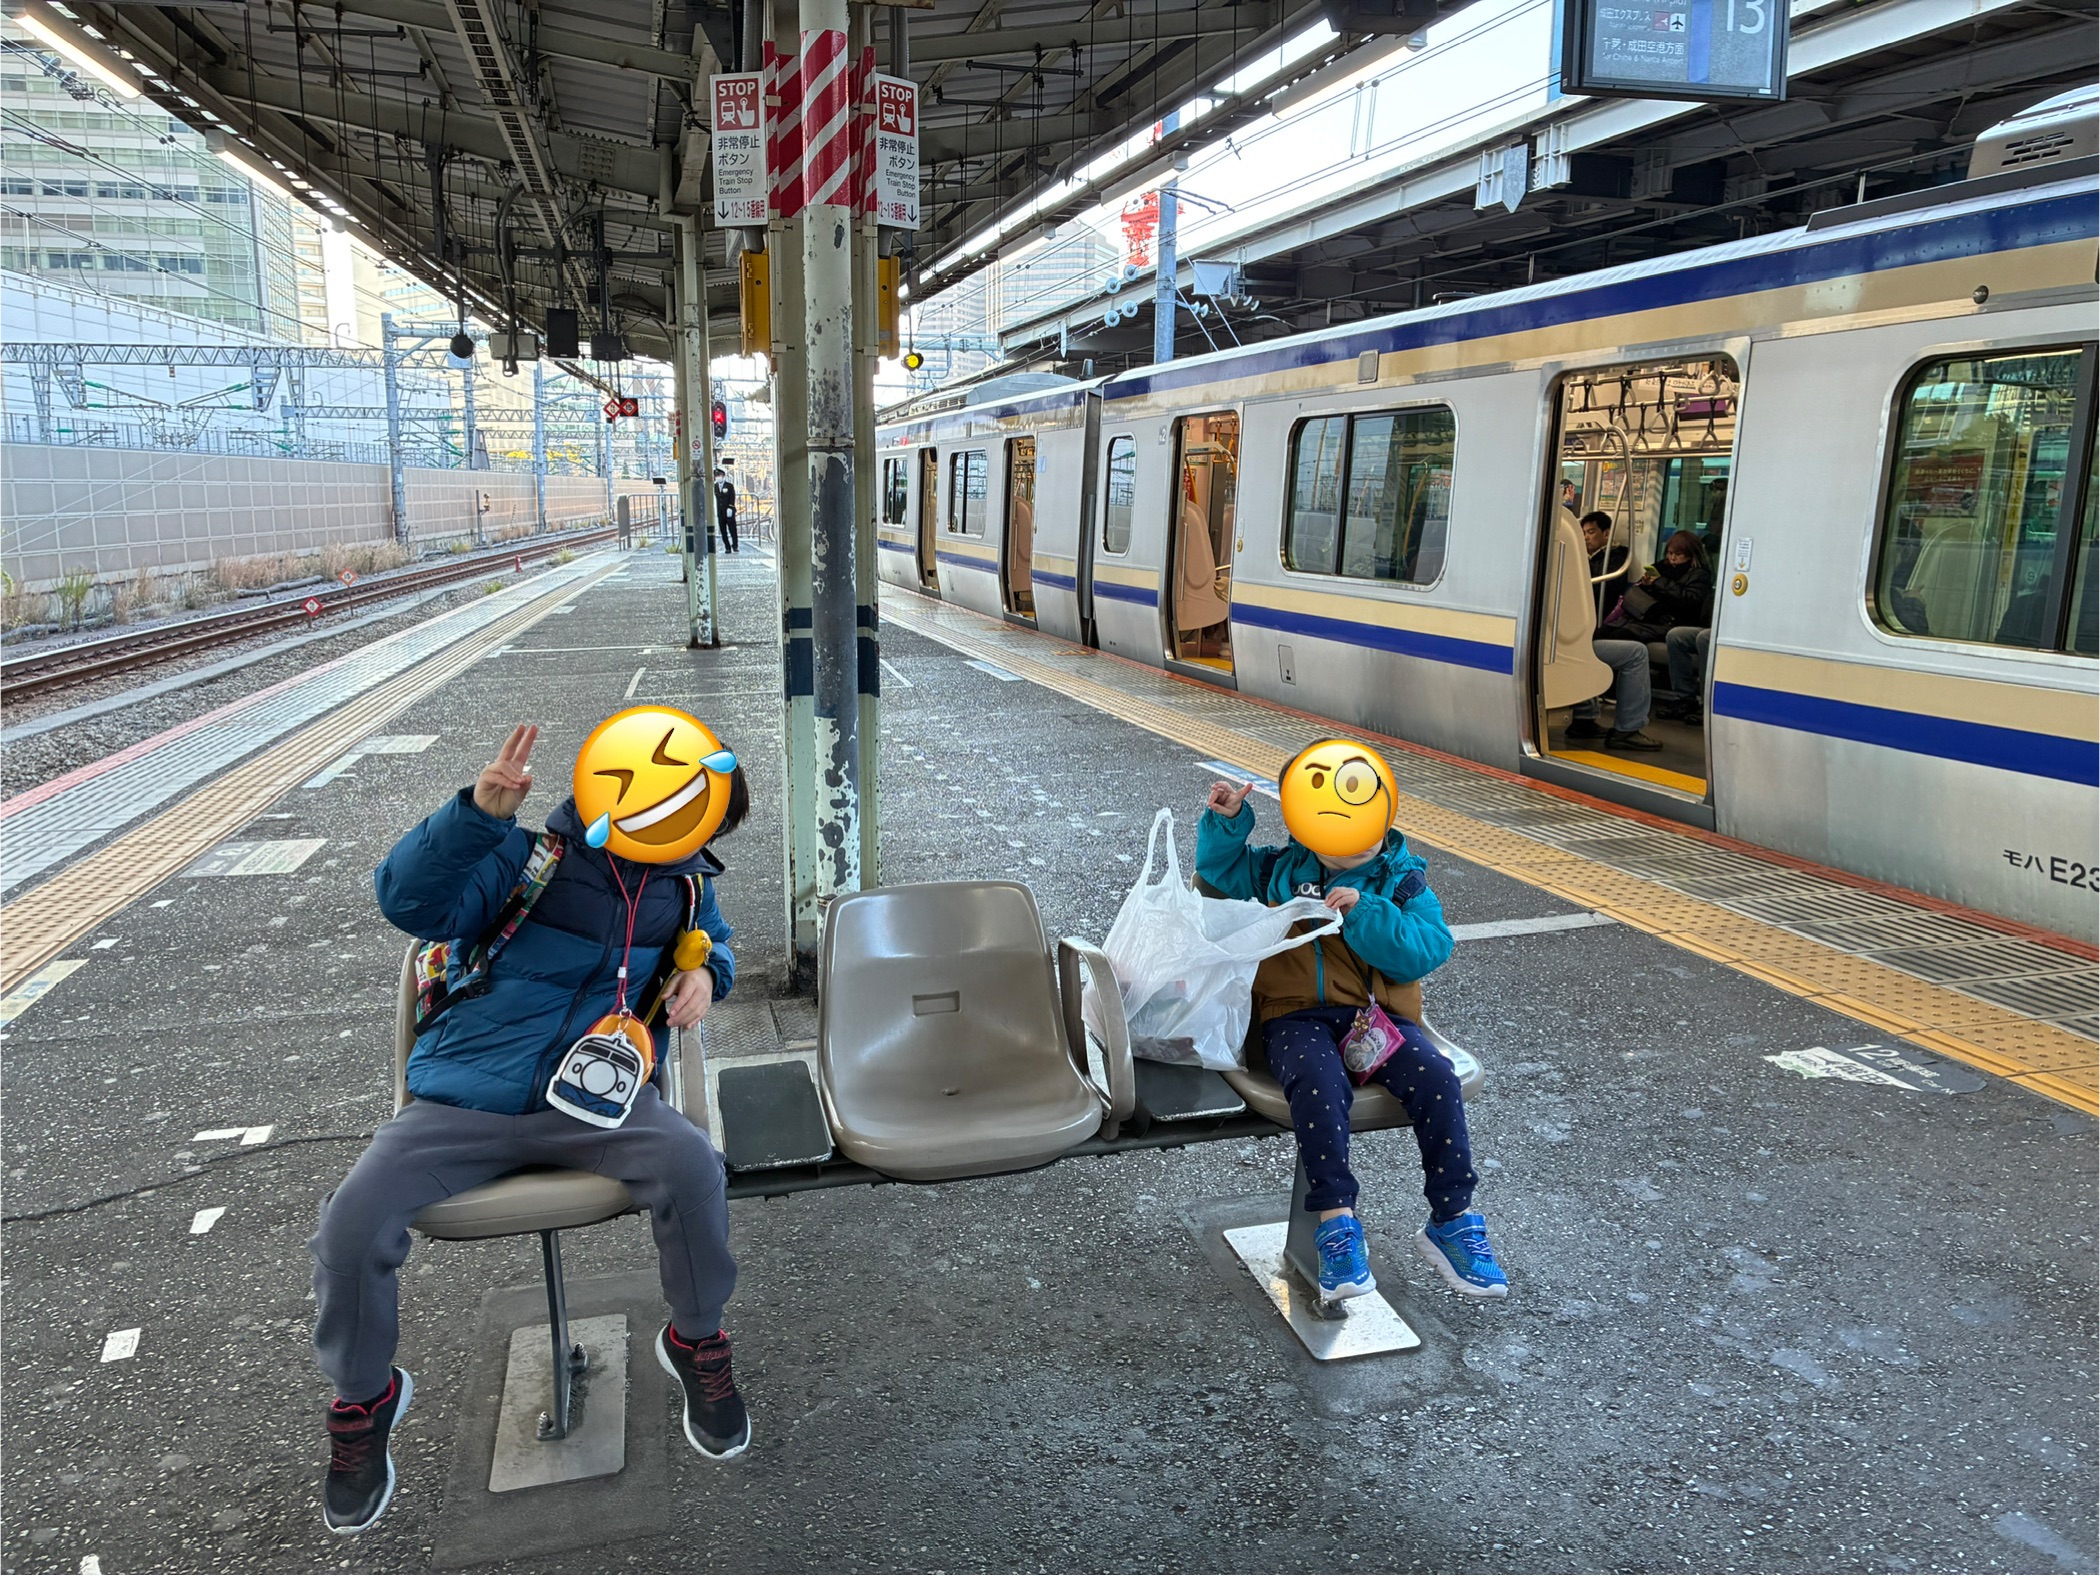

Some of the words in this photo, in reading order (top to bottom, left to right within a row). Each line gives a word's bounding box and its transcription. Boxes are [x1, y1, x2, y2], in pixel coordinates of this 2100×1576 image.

[719, 82, 755, 96] STOP
[881, 85, 912, 102] STOP
[718, 135, 760, 150] 非常停止
[880, 137, 915, 155] 非常停止
[719, 153, 749, 166] ボタン
[889, 155, 915, 170] ボタン
[719, 169, 753, 177] Emergency
[885, 169, 915, 181] Emergency
[719, 177, 735, 185] Train
[737, 177, 753, 186] Stop
[887, 178, 901, 187] Train
[902, 181, 915, 190] Stop
[896, 189, 915, 198] Button
[1847, 1044, 1900, 1060] 12
